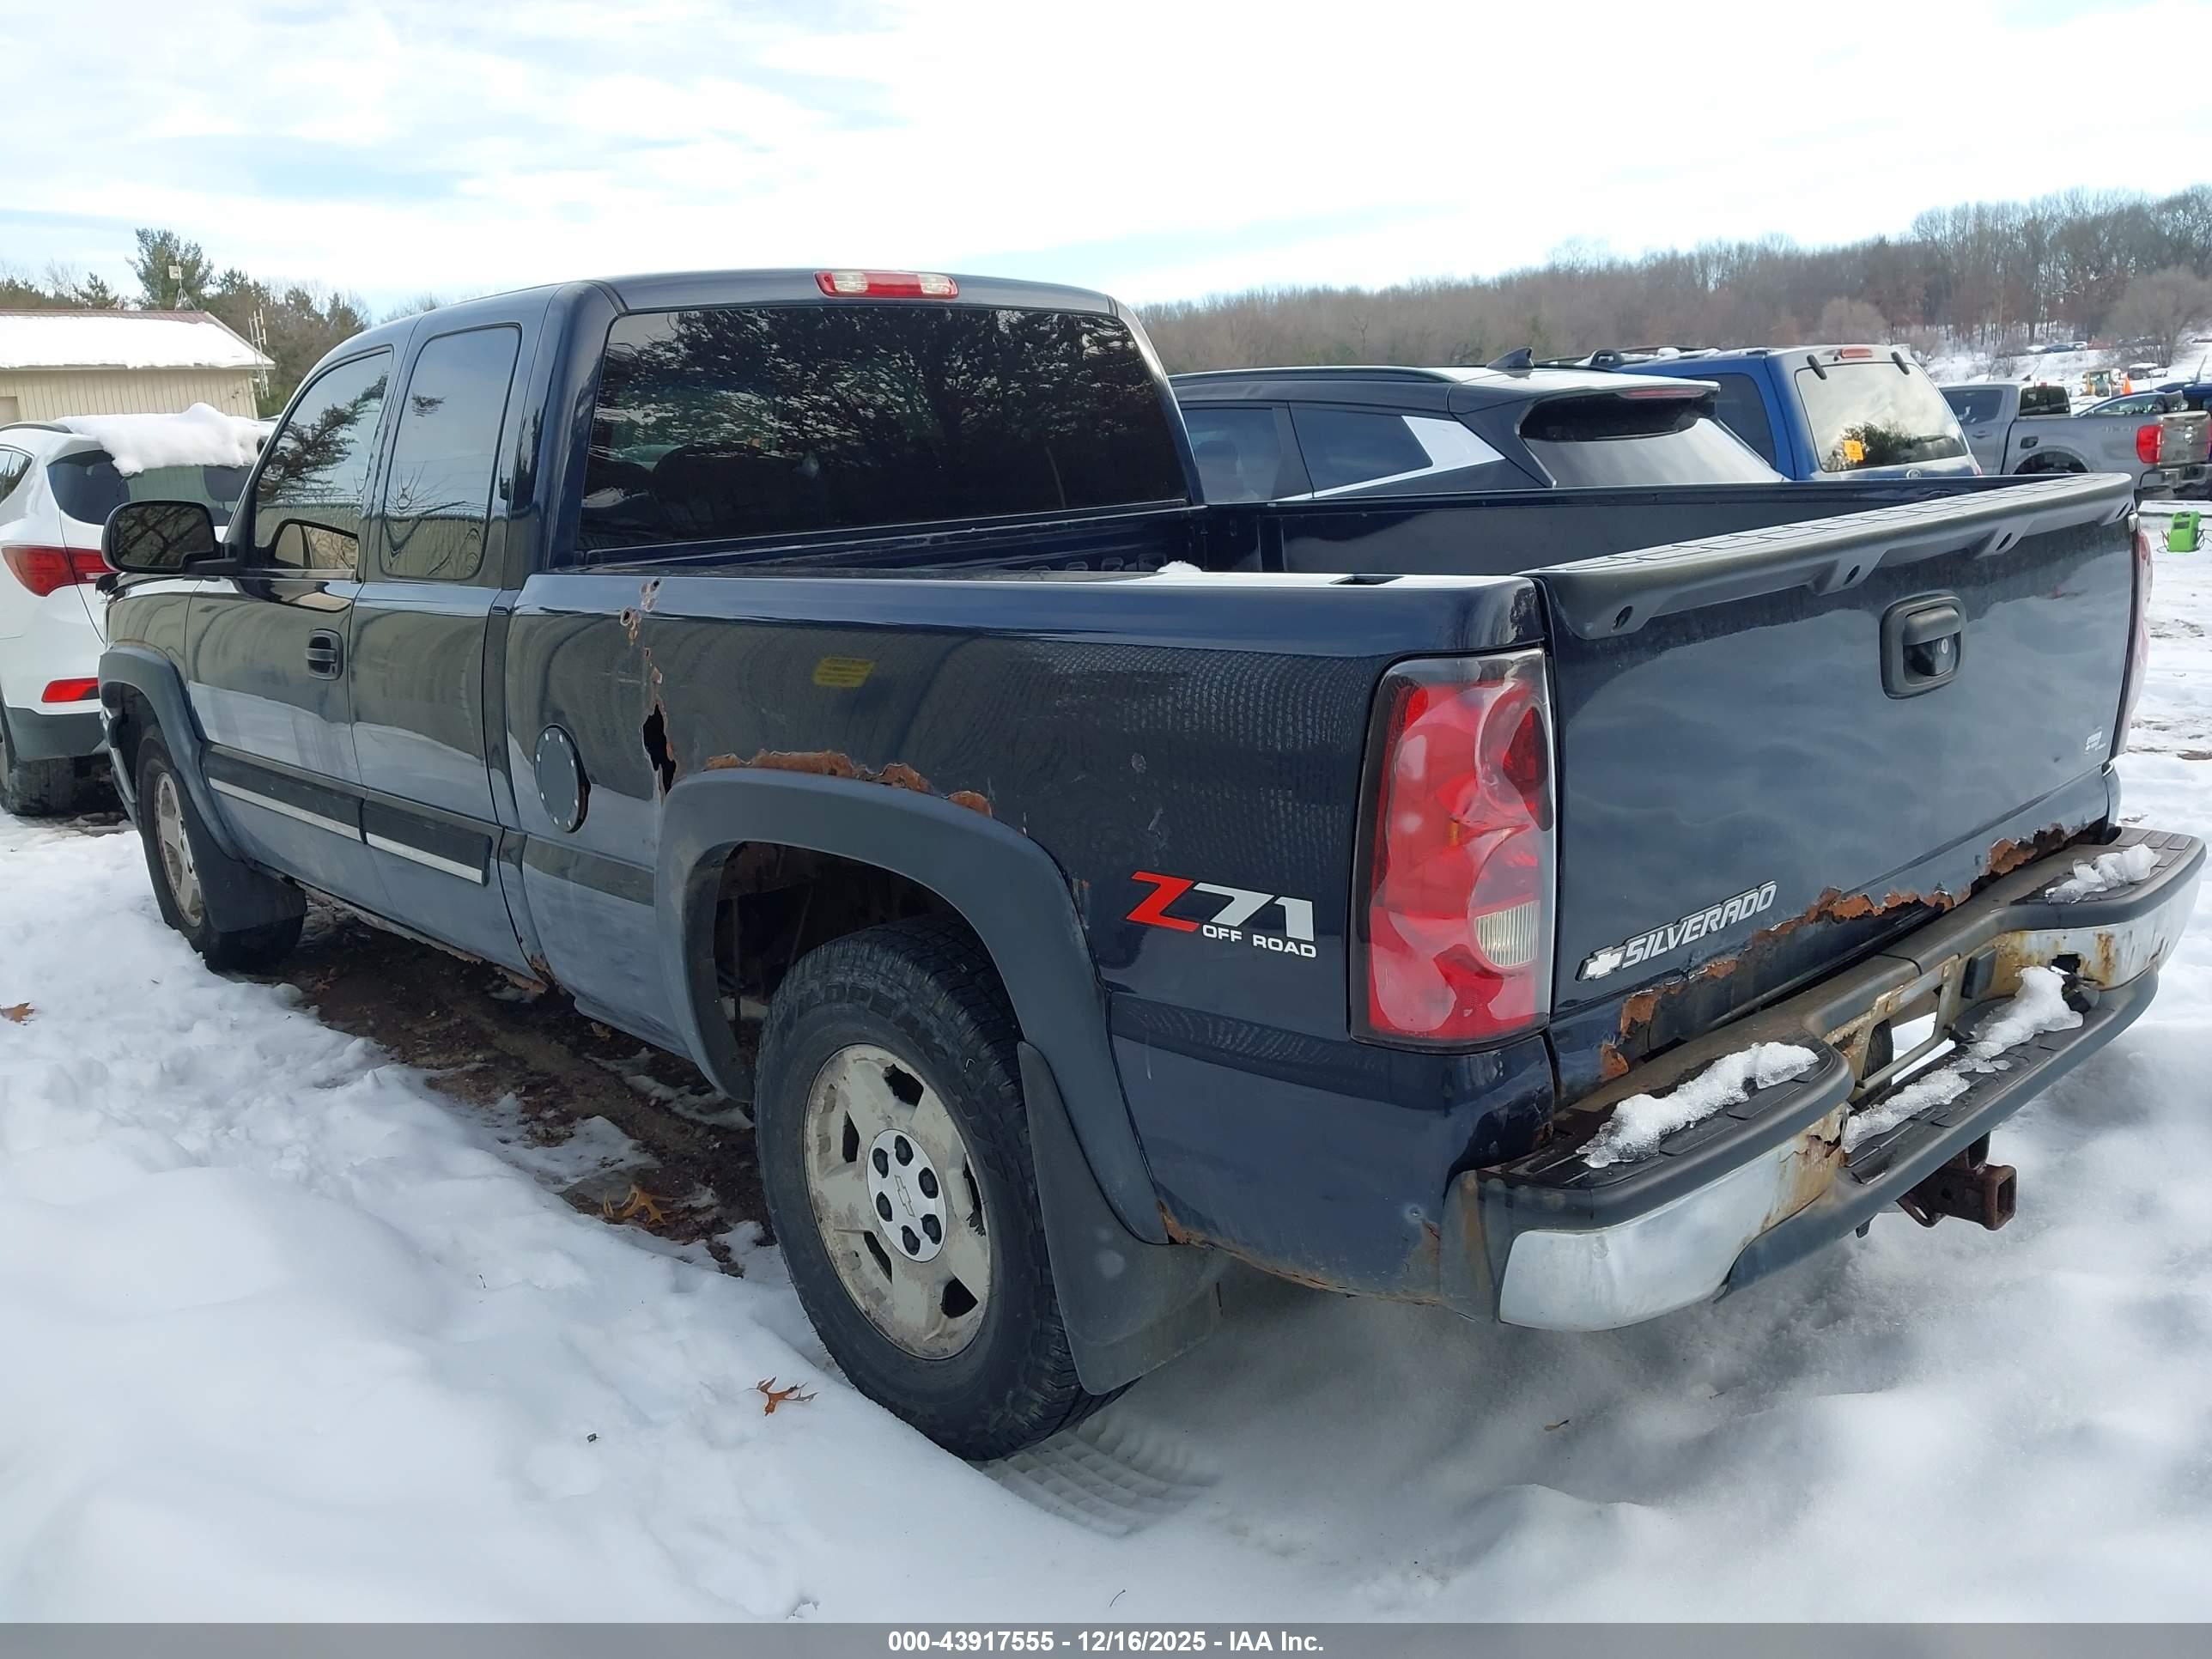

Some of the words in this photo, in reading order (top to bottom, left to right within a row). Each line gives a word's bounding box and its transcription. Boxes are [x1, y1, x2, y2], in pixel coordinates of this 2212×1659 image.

[1126, 871, 1314, 942] Z71
[1202, 924, 1243, 942] OFF
[1252, 934, 1316, 958] ROAD
[1621, 882, 1778, 969] SILVERADO
